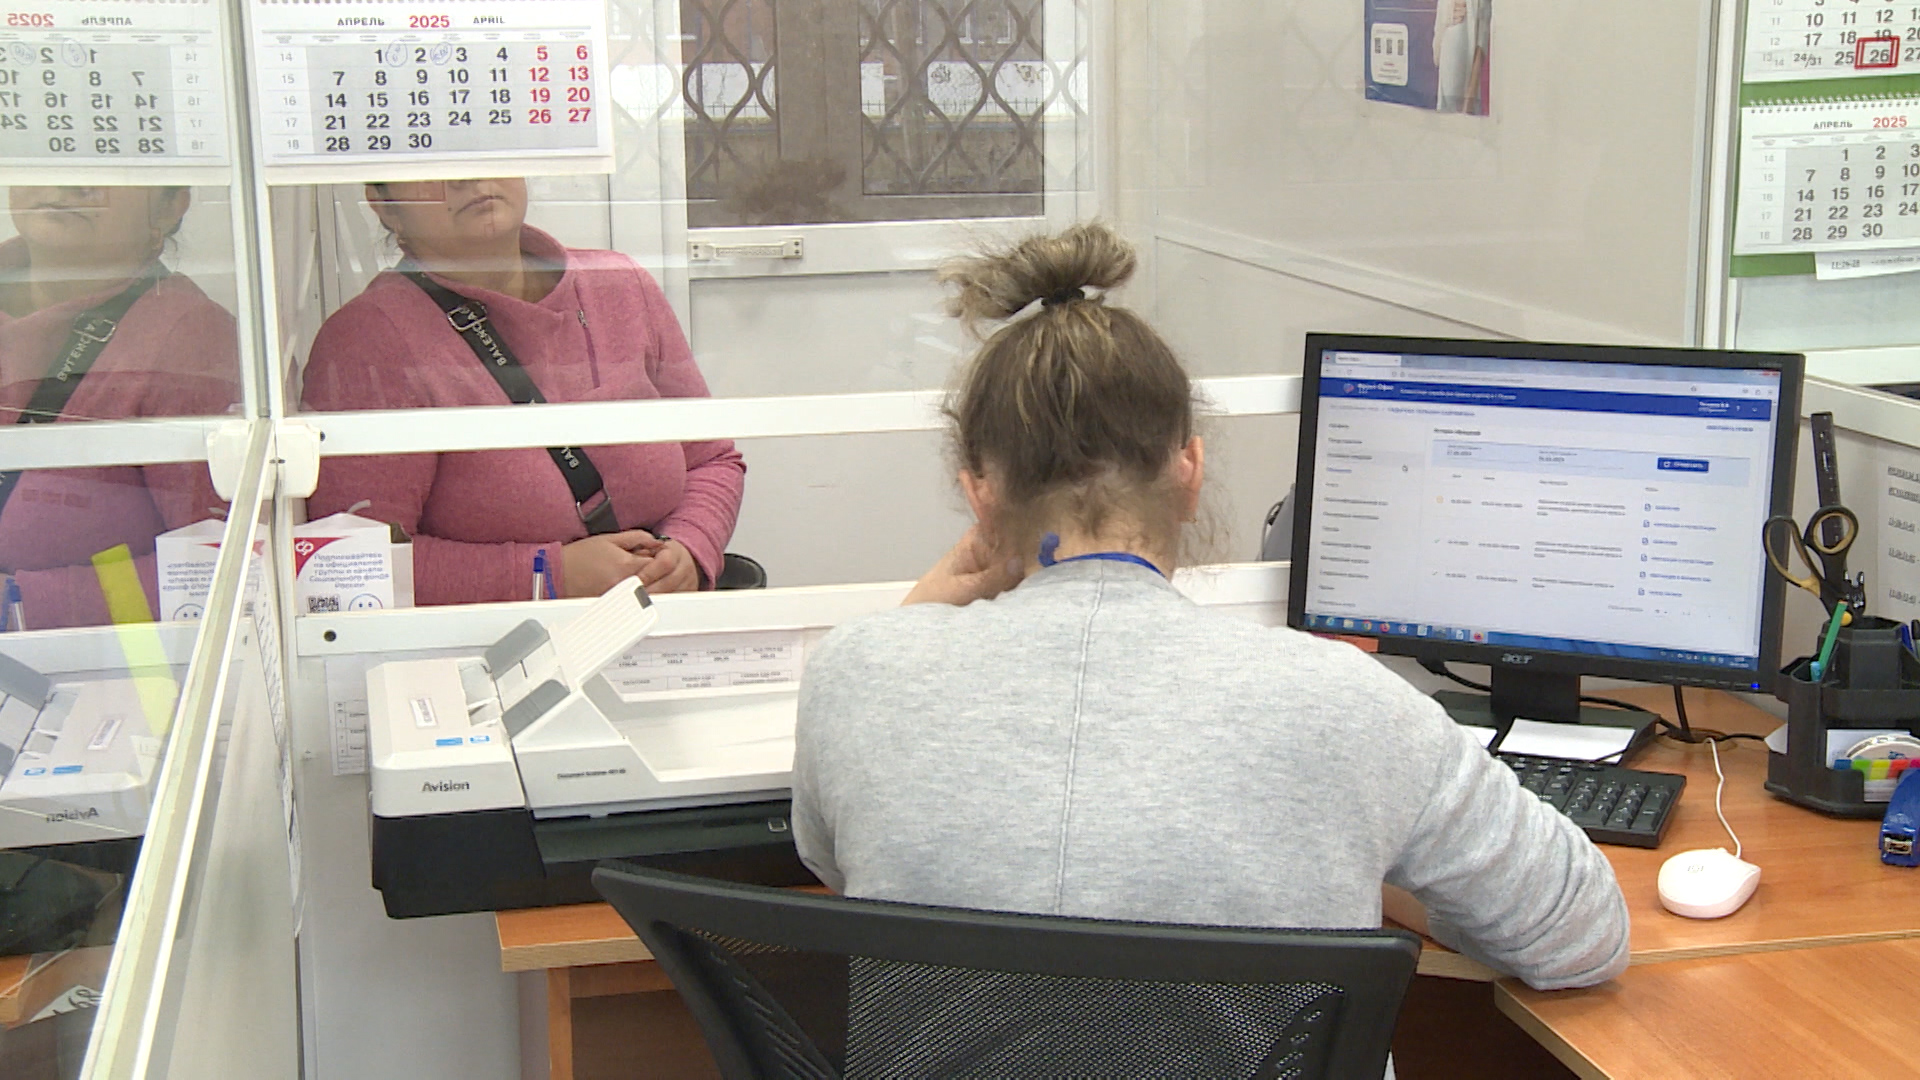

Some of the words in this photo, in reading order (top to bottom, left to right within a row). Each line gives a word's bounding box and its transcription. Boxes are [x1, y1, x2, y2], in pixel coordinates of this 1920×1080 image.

[337, 17, 385, 27] АПРЕЛЬ
[409, 14, 450, 28] 2025
[473, 15, 506, 25] APRIL
[1806, 13, 1824, 27] 10
[1842, 11, 1857, 25] 11
[1876, 9, 1894, 24] 12
[1804, 33, 1823, 47] 17
[1839, 31, 1857, 45] 18
[280, 53, 293, 62] 14
[374, 48, 383, 64] 1
[415, 47, 427, 63] 2
[455, 47, 468, 62] 3
[496, 47, 508, 62] 4
[536, 45, 548, 61] 5
[576, 45, 588, 61] 6
[1834, 51, 1855, 66] 25
[1869, 49, 1890, 63] 26
[282, 74, 295, 84] 15
[332, 71, 345, 86] 7
[375, 69, 387, 86] 8
[416, 69, 428, 84] 9
[448, 68, 469, 84] 10
[489, 68, 507, 82] 11
[529, 67, 550, 82] 12
[568, 65, 589, 81] 13
[283, 96, 296, 106] 16
[325, 93, 347, 108] 14
[366, 92, 389, 108] 15
[408, 90, 429, 106] 16
[449, 89, 471, 104] 17
[489, 89, 511, 104] 18
[529, 87, 551, 103] 19
[567, 87, 590, 102] 20
[285, 118, 297, 128] 17
[325, 115, 346, 130] 21
[366, 113, 390, 130] 22
[407, 112, 431, 128] 23
[448, 111, 472, 126] 24
[489, 109, 512, 124] 25
[528, 109, 551, 124] 26
[568, 107, 591, 123] 27
[1813, 121, 1853, 130] АПРЕЛЬ
[1872, 116, 1908, 129] 2025
[325, 136, 350, 152] 28
[368, 135, 391, 150] 29
[408, 133, 432, 148] 30
[1841, 148, 1849, 161] 1
[1875, 146, 1886, 160] 2
[1911, 144, 1920, 158] 3
[1805, 169, 1816, 182] 7
[1840, 167, 1850, 181] 8
[1875, 165, 1885, 179] 9
[1902, 163, 1920, 177] 10
[1797, 189, 1815, 202] 14
[1831, 187, 1849, 200] 15
[1867, 185, 1884, 198] 16
[1901, 183, 1920, 196] 17
[1794, 208, 1812, 222] 21
[1828, 206, 1848, 219] 22
[1863, 204, 1883, 218] 23
[1898, 202, 1919, 216] 24
[1792, 227, 1813, 240] 28
[1827, 225, 1848, 239] 29
[1862, 223, 1883, 237] 30
[1502, 653, 1533, 664] acer
[422, 780, 470, 792] Avision
